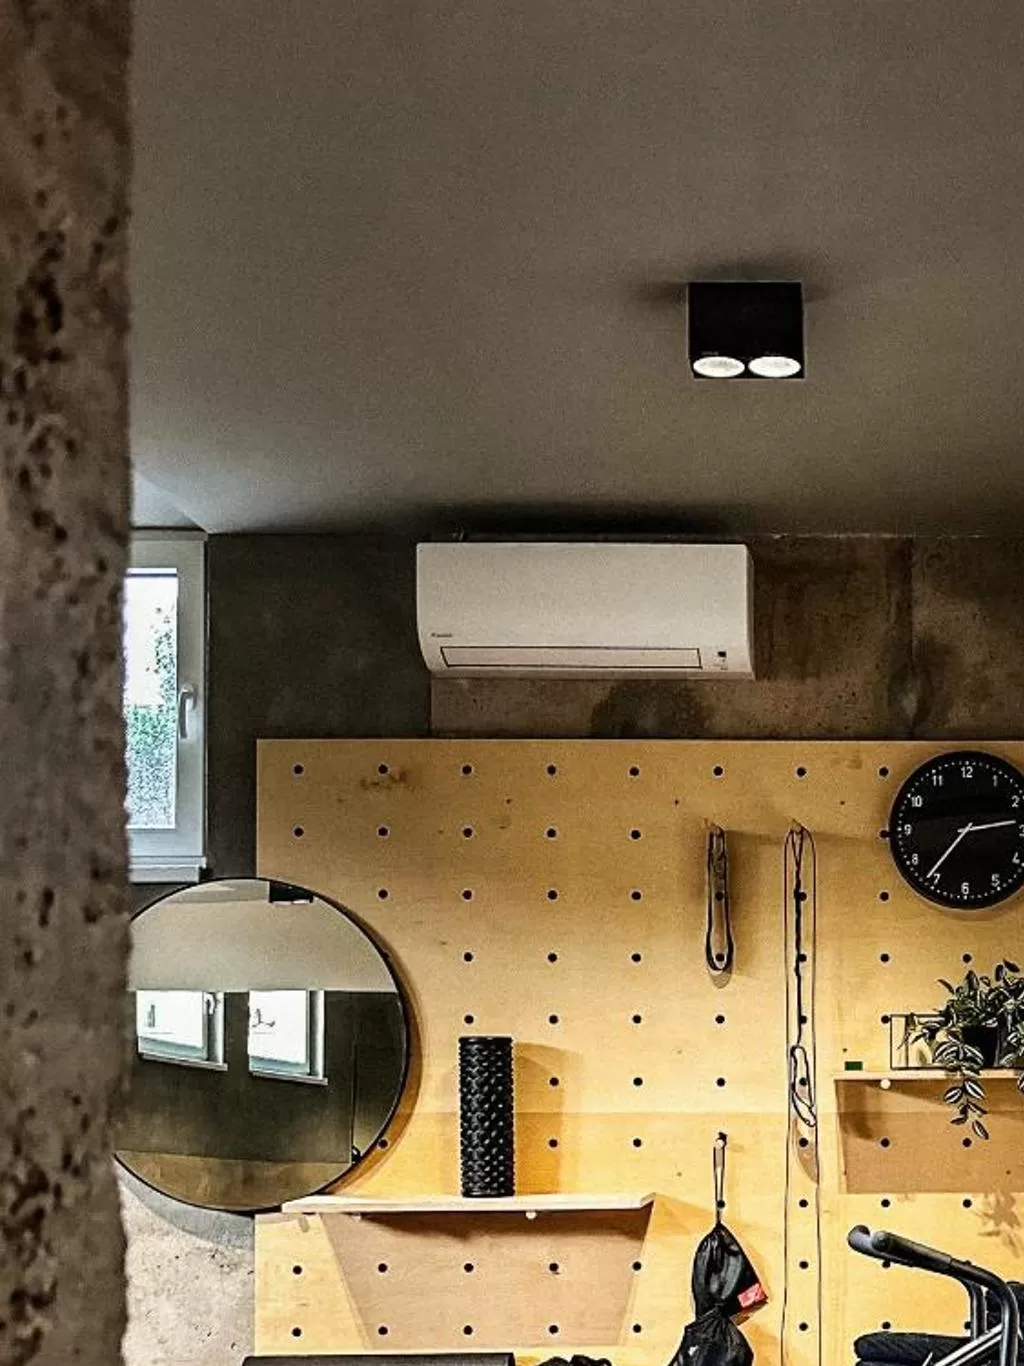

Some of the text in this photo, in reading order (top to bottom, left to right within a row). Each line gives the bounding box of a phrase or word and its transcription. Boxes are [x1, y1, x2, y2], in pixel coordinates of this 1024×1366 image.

[961, 766, 973, 778] 12
[932, 775, 943, 786] 11
[992, 776, 999, 787] 1
[911, 795, 922, 807] 10
[1011, 795, 1020, 807] 2
[904, 824, 912, 836] 9
[911, 853, 919, 865] 8
[1011, 852, 1020, 864] 4
[933, 873, 941, 885] 7
[991, 873, 1000, 887] 5
[961, 882, 970, 895] 6
